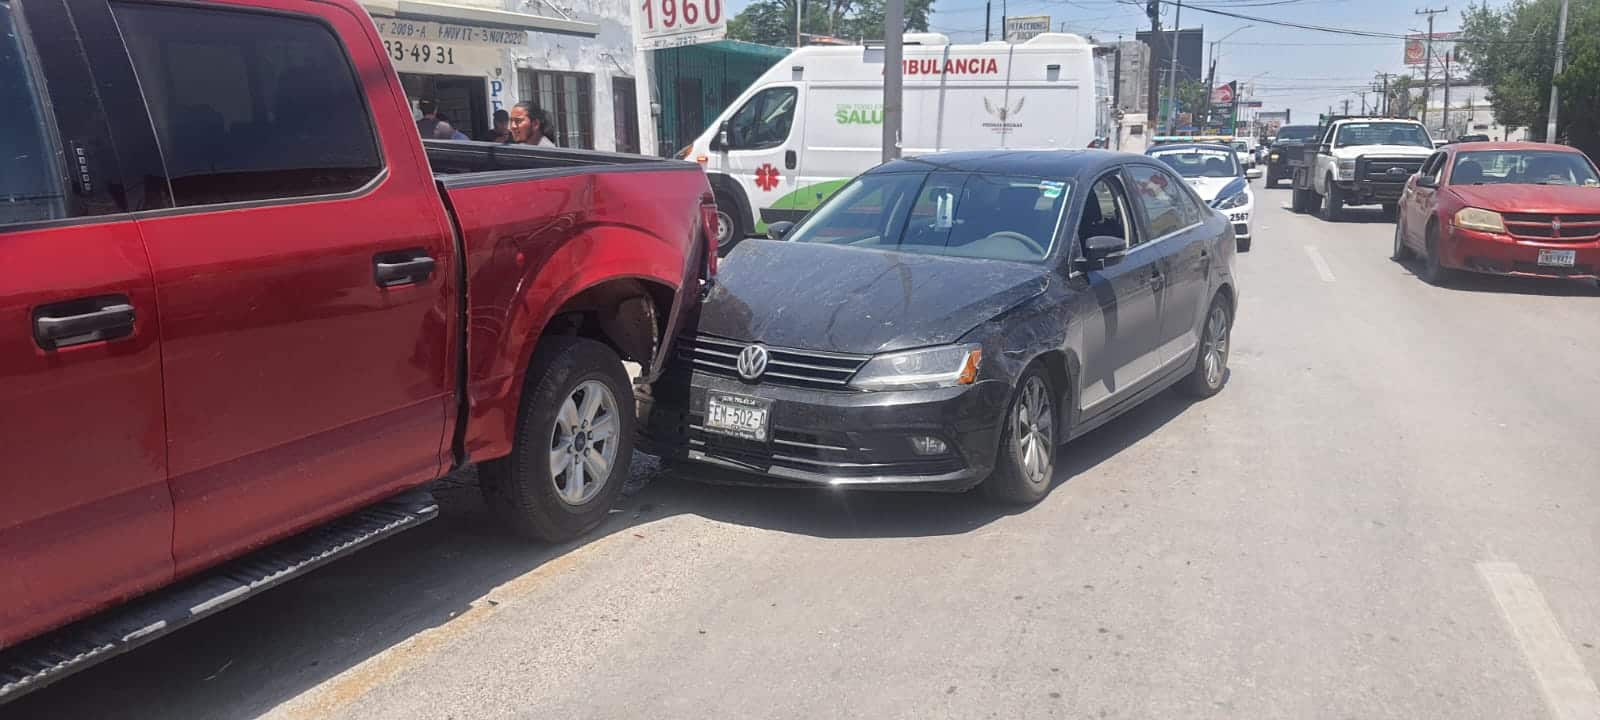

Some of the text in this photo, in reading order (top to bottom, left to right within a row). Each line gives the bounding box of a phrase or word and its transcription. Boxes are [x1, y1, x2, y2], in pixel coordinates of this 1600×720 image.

[642, 0, 721, 29] 1960
[882, 58, 998, 75] BULANCIA
[835, 110, 884, 124] SALU
[1230, 212, 1249, 222] 2567
